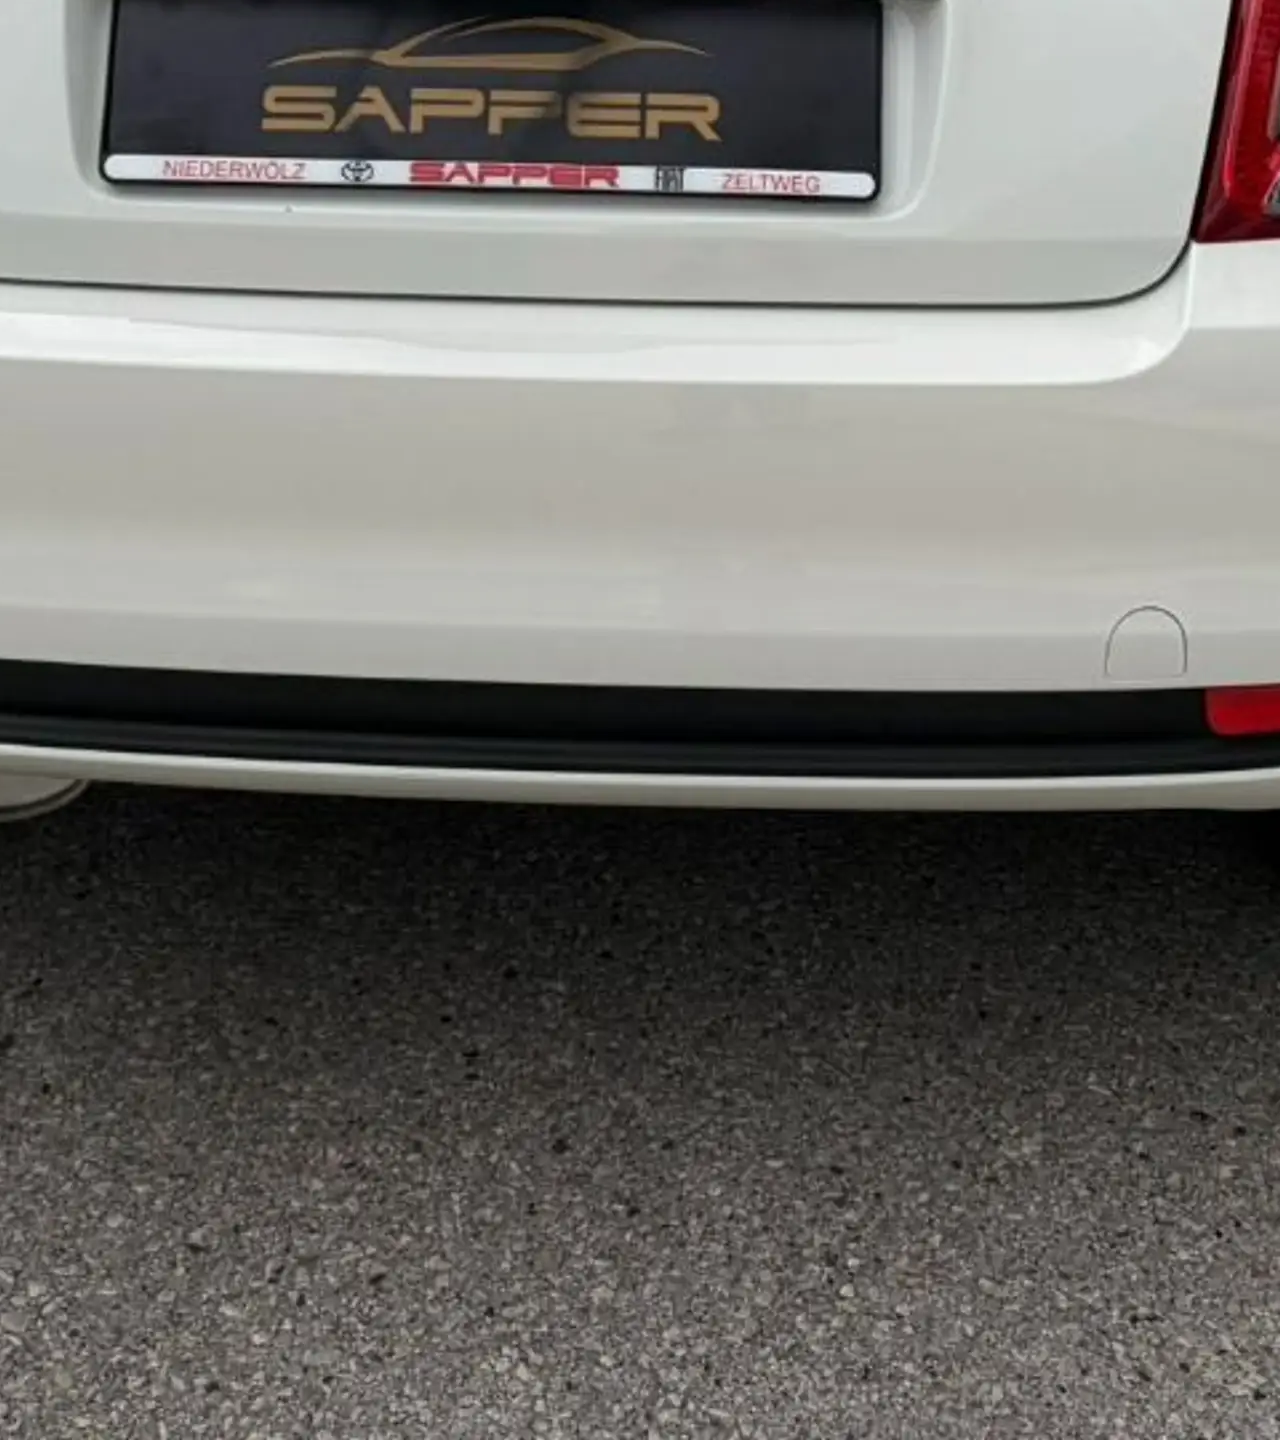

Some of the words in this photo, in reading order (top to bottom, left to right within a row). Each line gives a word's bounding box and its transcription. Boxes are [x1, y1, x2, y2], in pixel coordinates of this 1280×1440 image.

[162, 159, 307, 181] NIEDERWÖLZ
[408, 161, 620, 189] SAPPER
[655, 165, 685, 191] FIAT
[721, 172, 821, 195] ZELTWEG
